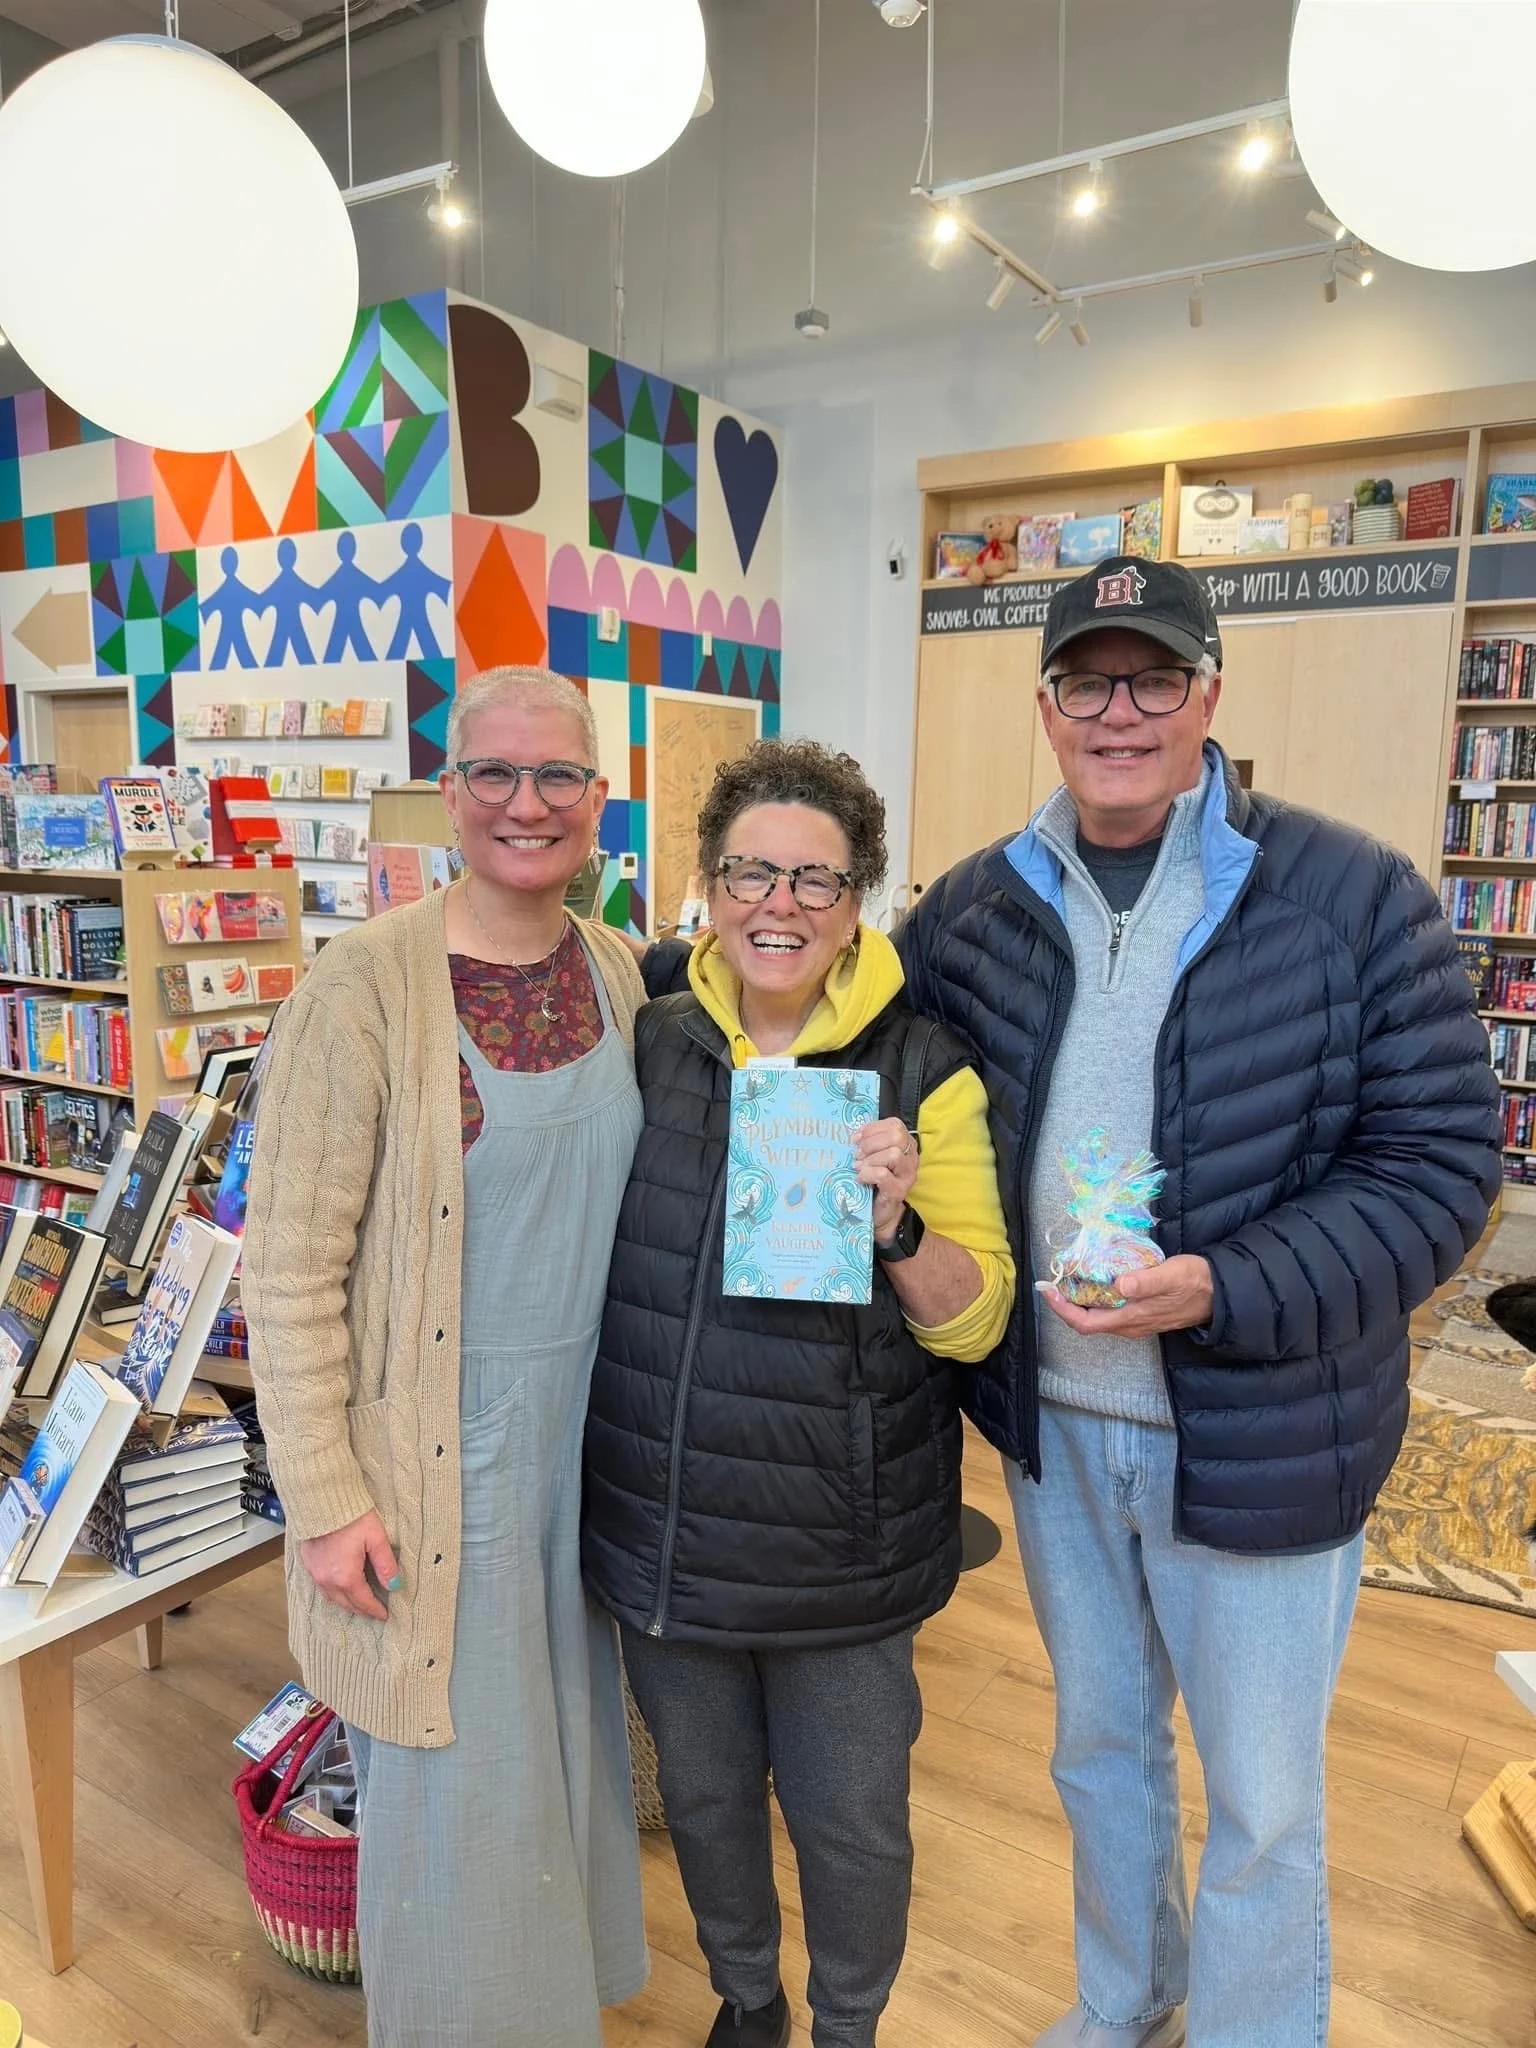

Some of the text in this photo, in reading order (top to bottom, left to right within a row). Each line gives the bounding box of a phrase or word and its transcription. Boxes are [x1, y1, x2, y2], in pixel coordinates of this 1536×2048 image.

[1243, 571, 1290, 603] WITH
[1295, 571, 1310, 600] A
[1376, 561, 1433, 596] BOOK
[983, 587, 1001, 604] WE
[1003, 583, 1055, 603] PROUDLY
[926, 608, 972, 631] SNOWY
[973, 607, 1001, 628] OWL
[113, 788, 160, 797] MURDLE
[81, 931, 121, 940] BILLION
[81, 941, 121, 950] DOLLAR
[81, 952, 115, 960] WHAL
[761, 1143, 834, 1169] WITCH
[151, 1257, 191, 1316] Wedding
